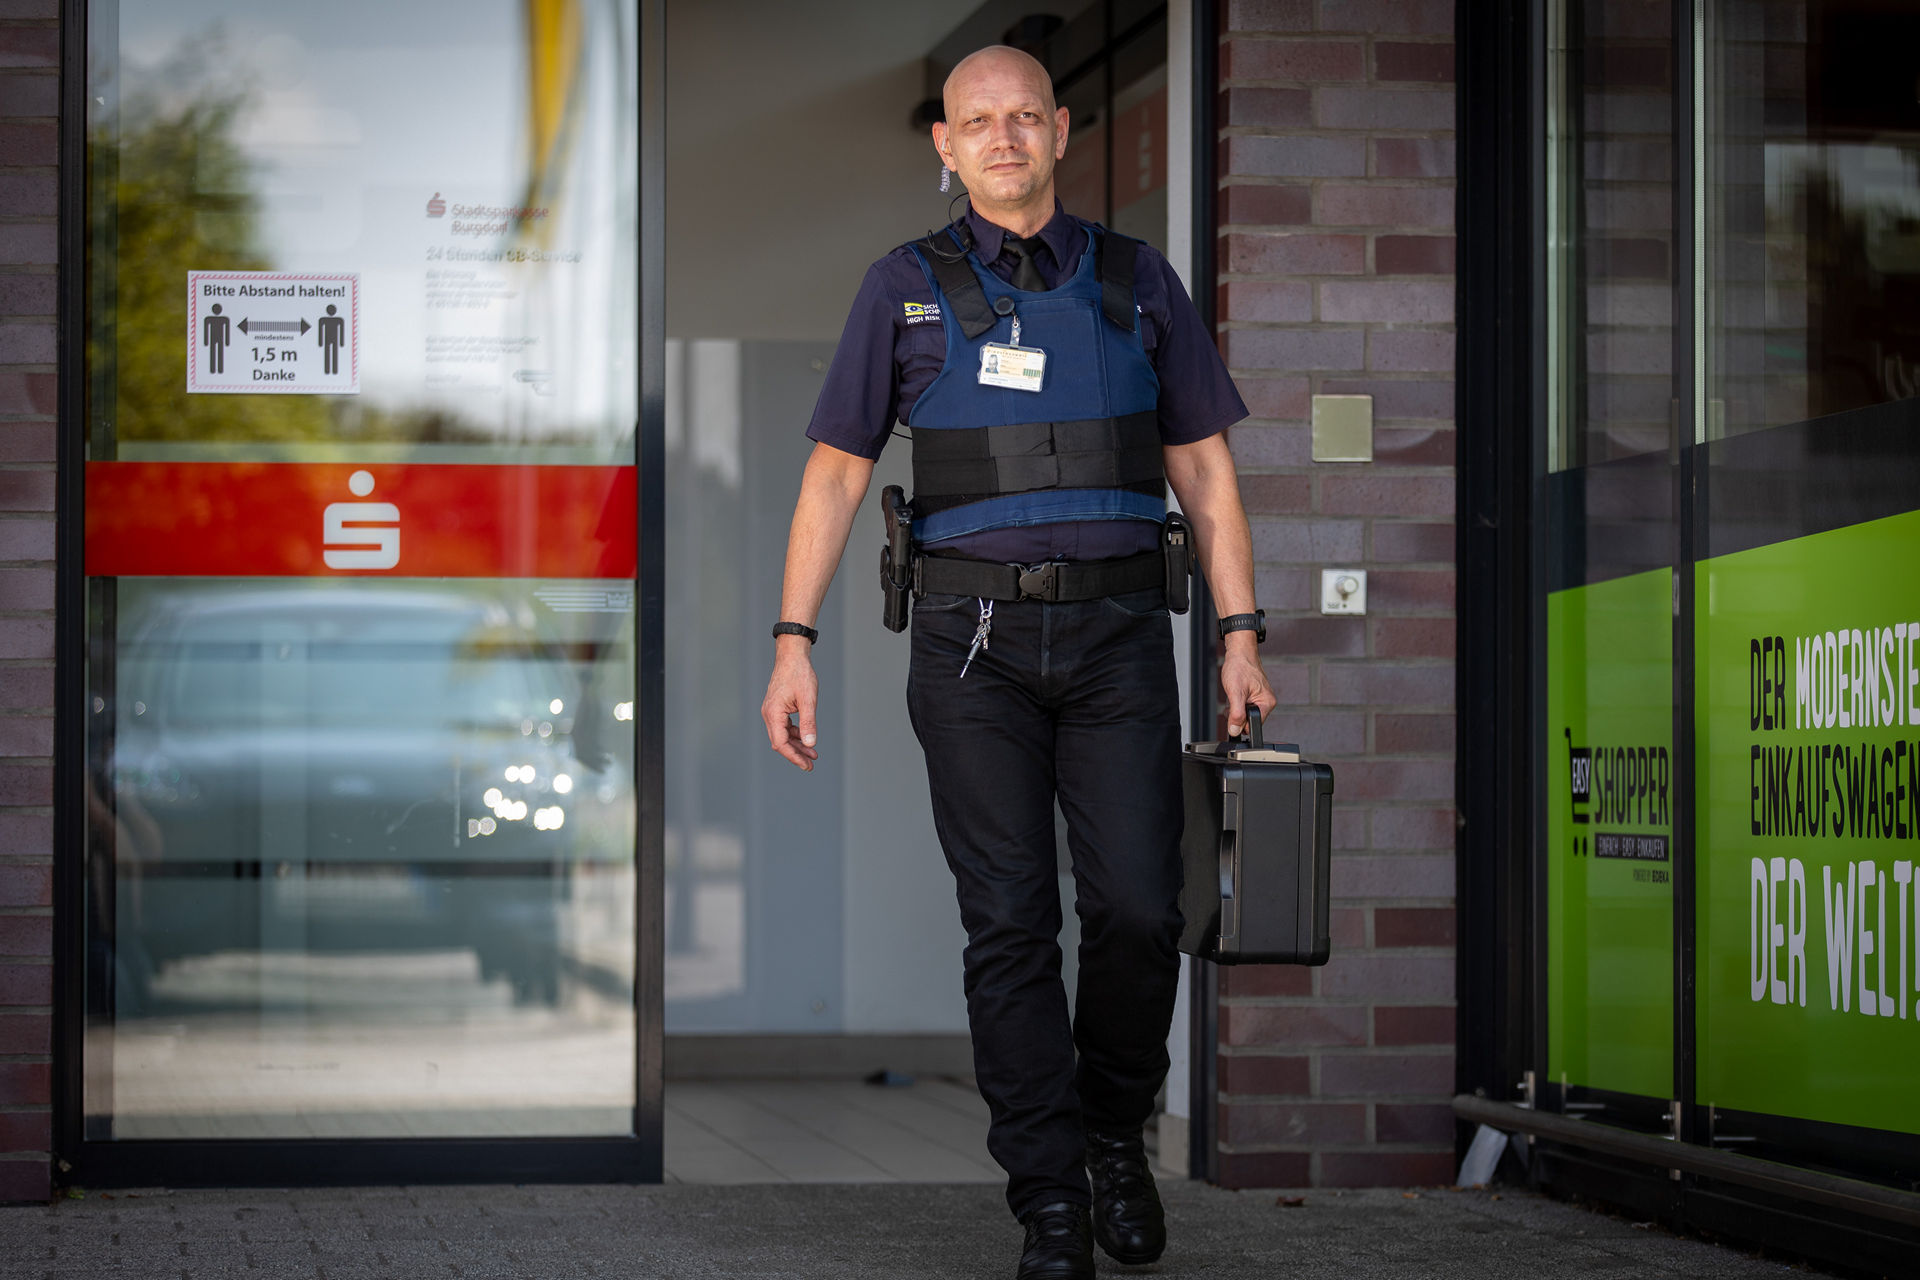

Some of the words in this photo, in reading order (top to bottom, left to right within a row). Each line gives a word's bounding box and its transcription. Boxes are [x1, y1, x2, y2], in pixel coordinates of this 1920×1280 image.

[203, 285, 235, 297] Bitte
[239, 285, 295, 297] Abstand
[299, 285, 346, 298] halten!
[906, 316, 924, 325] HIGH
[251, 347, 276, 364] 1,5
[281, 350, 298, 361] m
[253, 369, 296, 381] Danke
[1750, 636, 1786, 731] DER
[1796, 622, 1920, 730] MODERNSTE
[1572, 757, 1591, 794] EASY
[1594, 746, 1669, 826] SHOPPER
[1750, 857, 1806, 1008] DER
